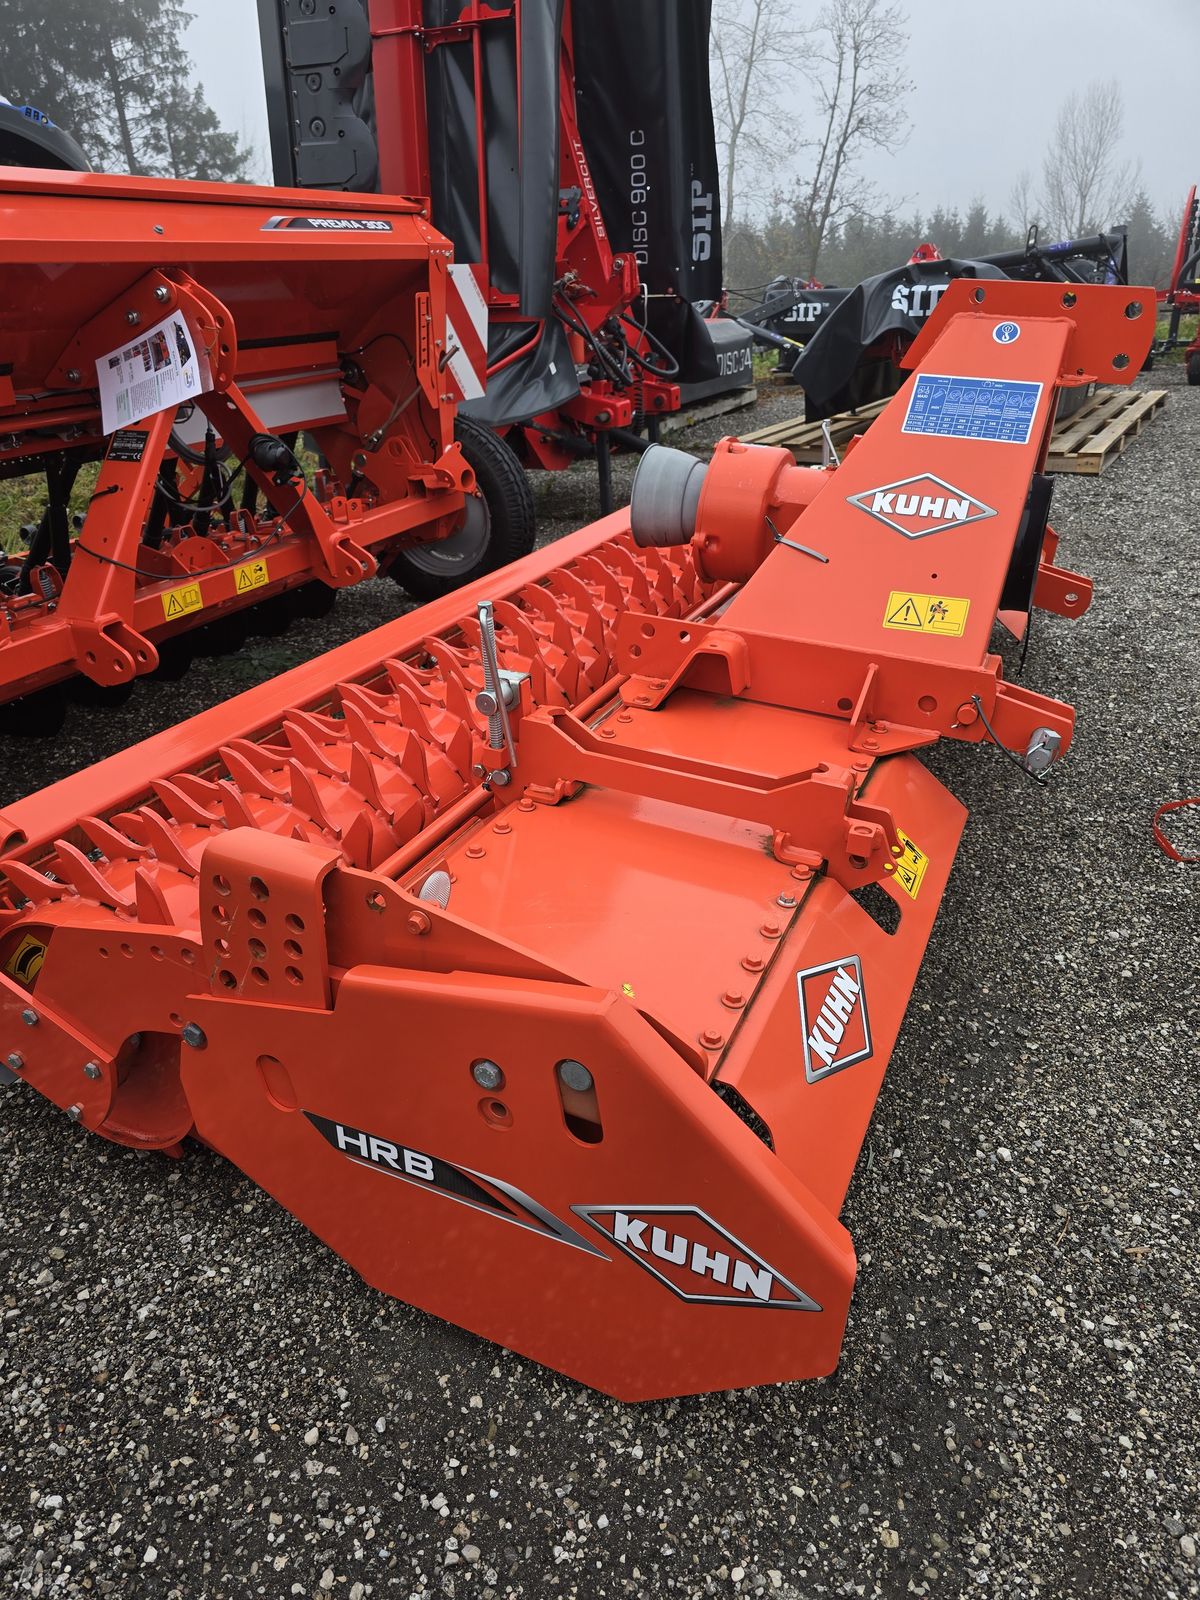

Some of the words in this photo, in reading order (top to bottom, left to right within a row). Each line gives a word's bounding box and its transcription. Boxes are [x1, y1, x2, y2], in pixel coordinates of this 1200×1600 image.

[630, 130, 645, 146] C
[572, 139, 606, 238] SILVERCUT
[630, 154, 646, 204] 900
[306, 218, 362, 229] PREMIA
[363, 220, 390, 230] 300
[632, 211, 649, 265] DISC
[691, 179, 713, 262] SIP
[871, 492, 970, 520] KUHN
[807, 966, 861, 1067] KUHN
[335, 1124, 435, 1181] HRB
[613, 1211, 773, 1302] KUHN
